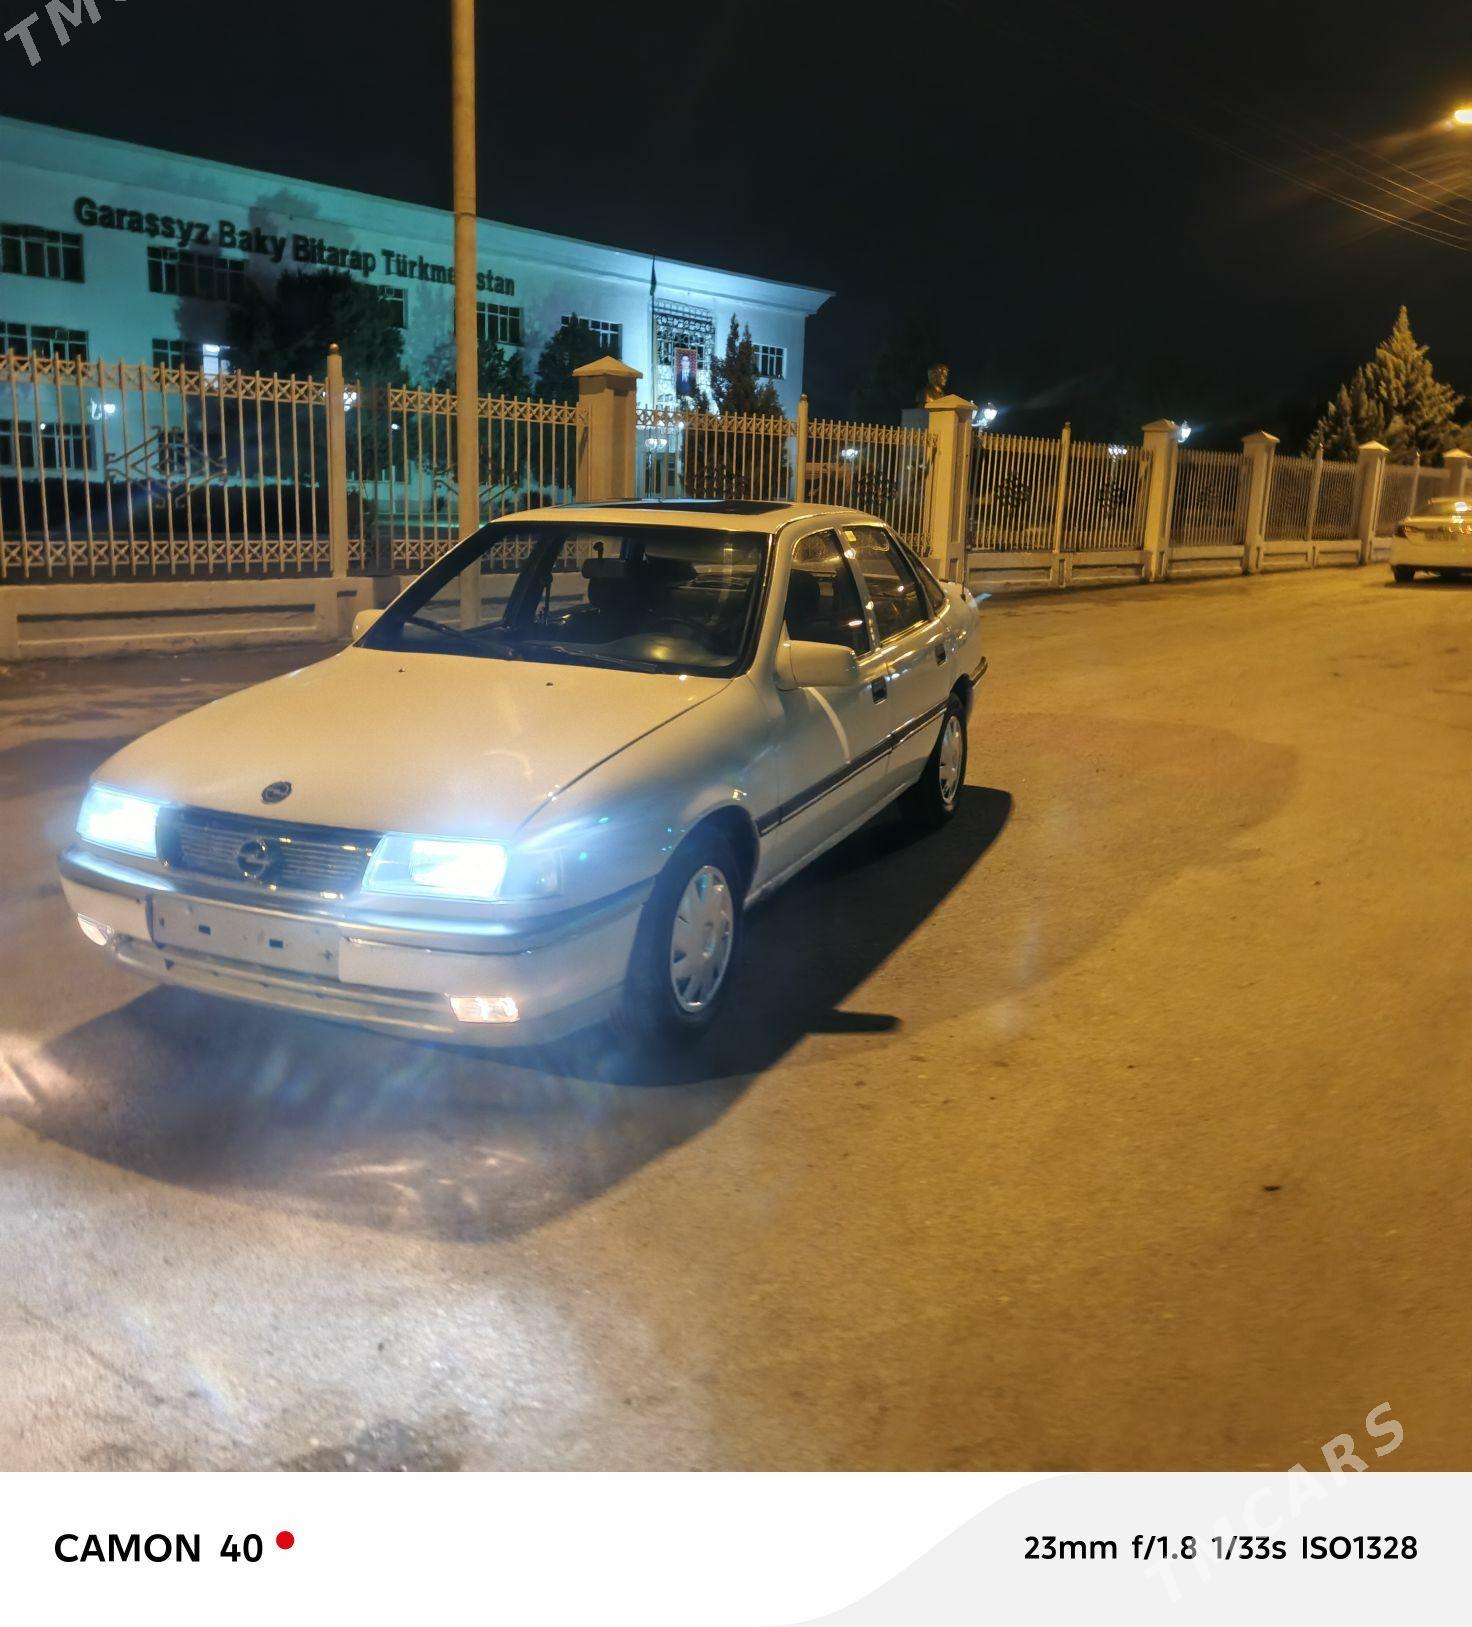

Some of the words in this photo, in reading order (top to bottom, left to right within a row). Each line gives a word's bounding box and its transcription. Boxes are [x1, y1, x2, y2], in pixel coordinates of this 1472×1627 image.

[73, 196, 211, 248] Garaşsyz
[218, 220, 286, 263] Baky
[292, 234, 376, 277] Bitarap
[381, 249, 516, 297] Türkmestan
